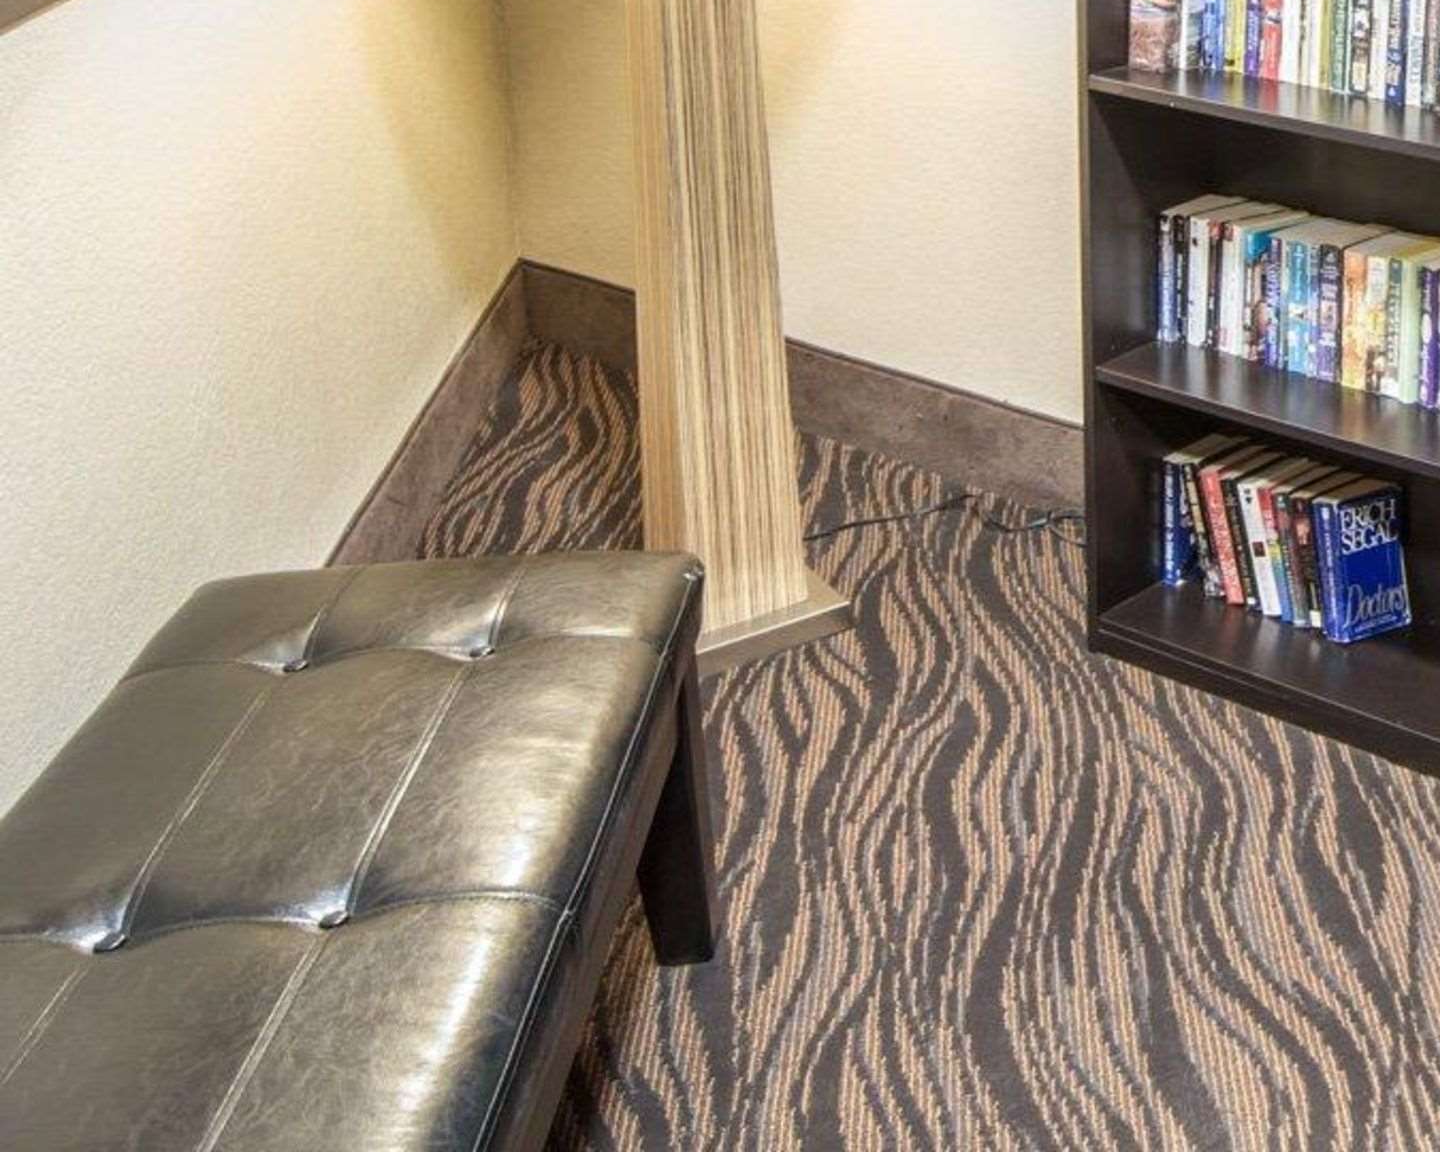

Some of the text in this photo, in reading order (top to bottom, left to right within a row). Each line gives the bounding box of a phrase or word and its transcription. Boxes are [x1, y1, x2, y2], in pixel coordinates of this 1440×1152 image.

[1339, 498, 1397, 532] ERICH
[1340, 522, 1400, 555] SEGAL
[1343, 582, 1408, 628] Doctors
